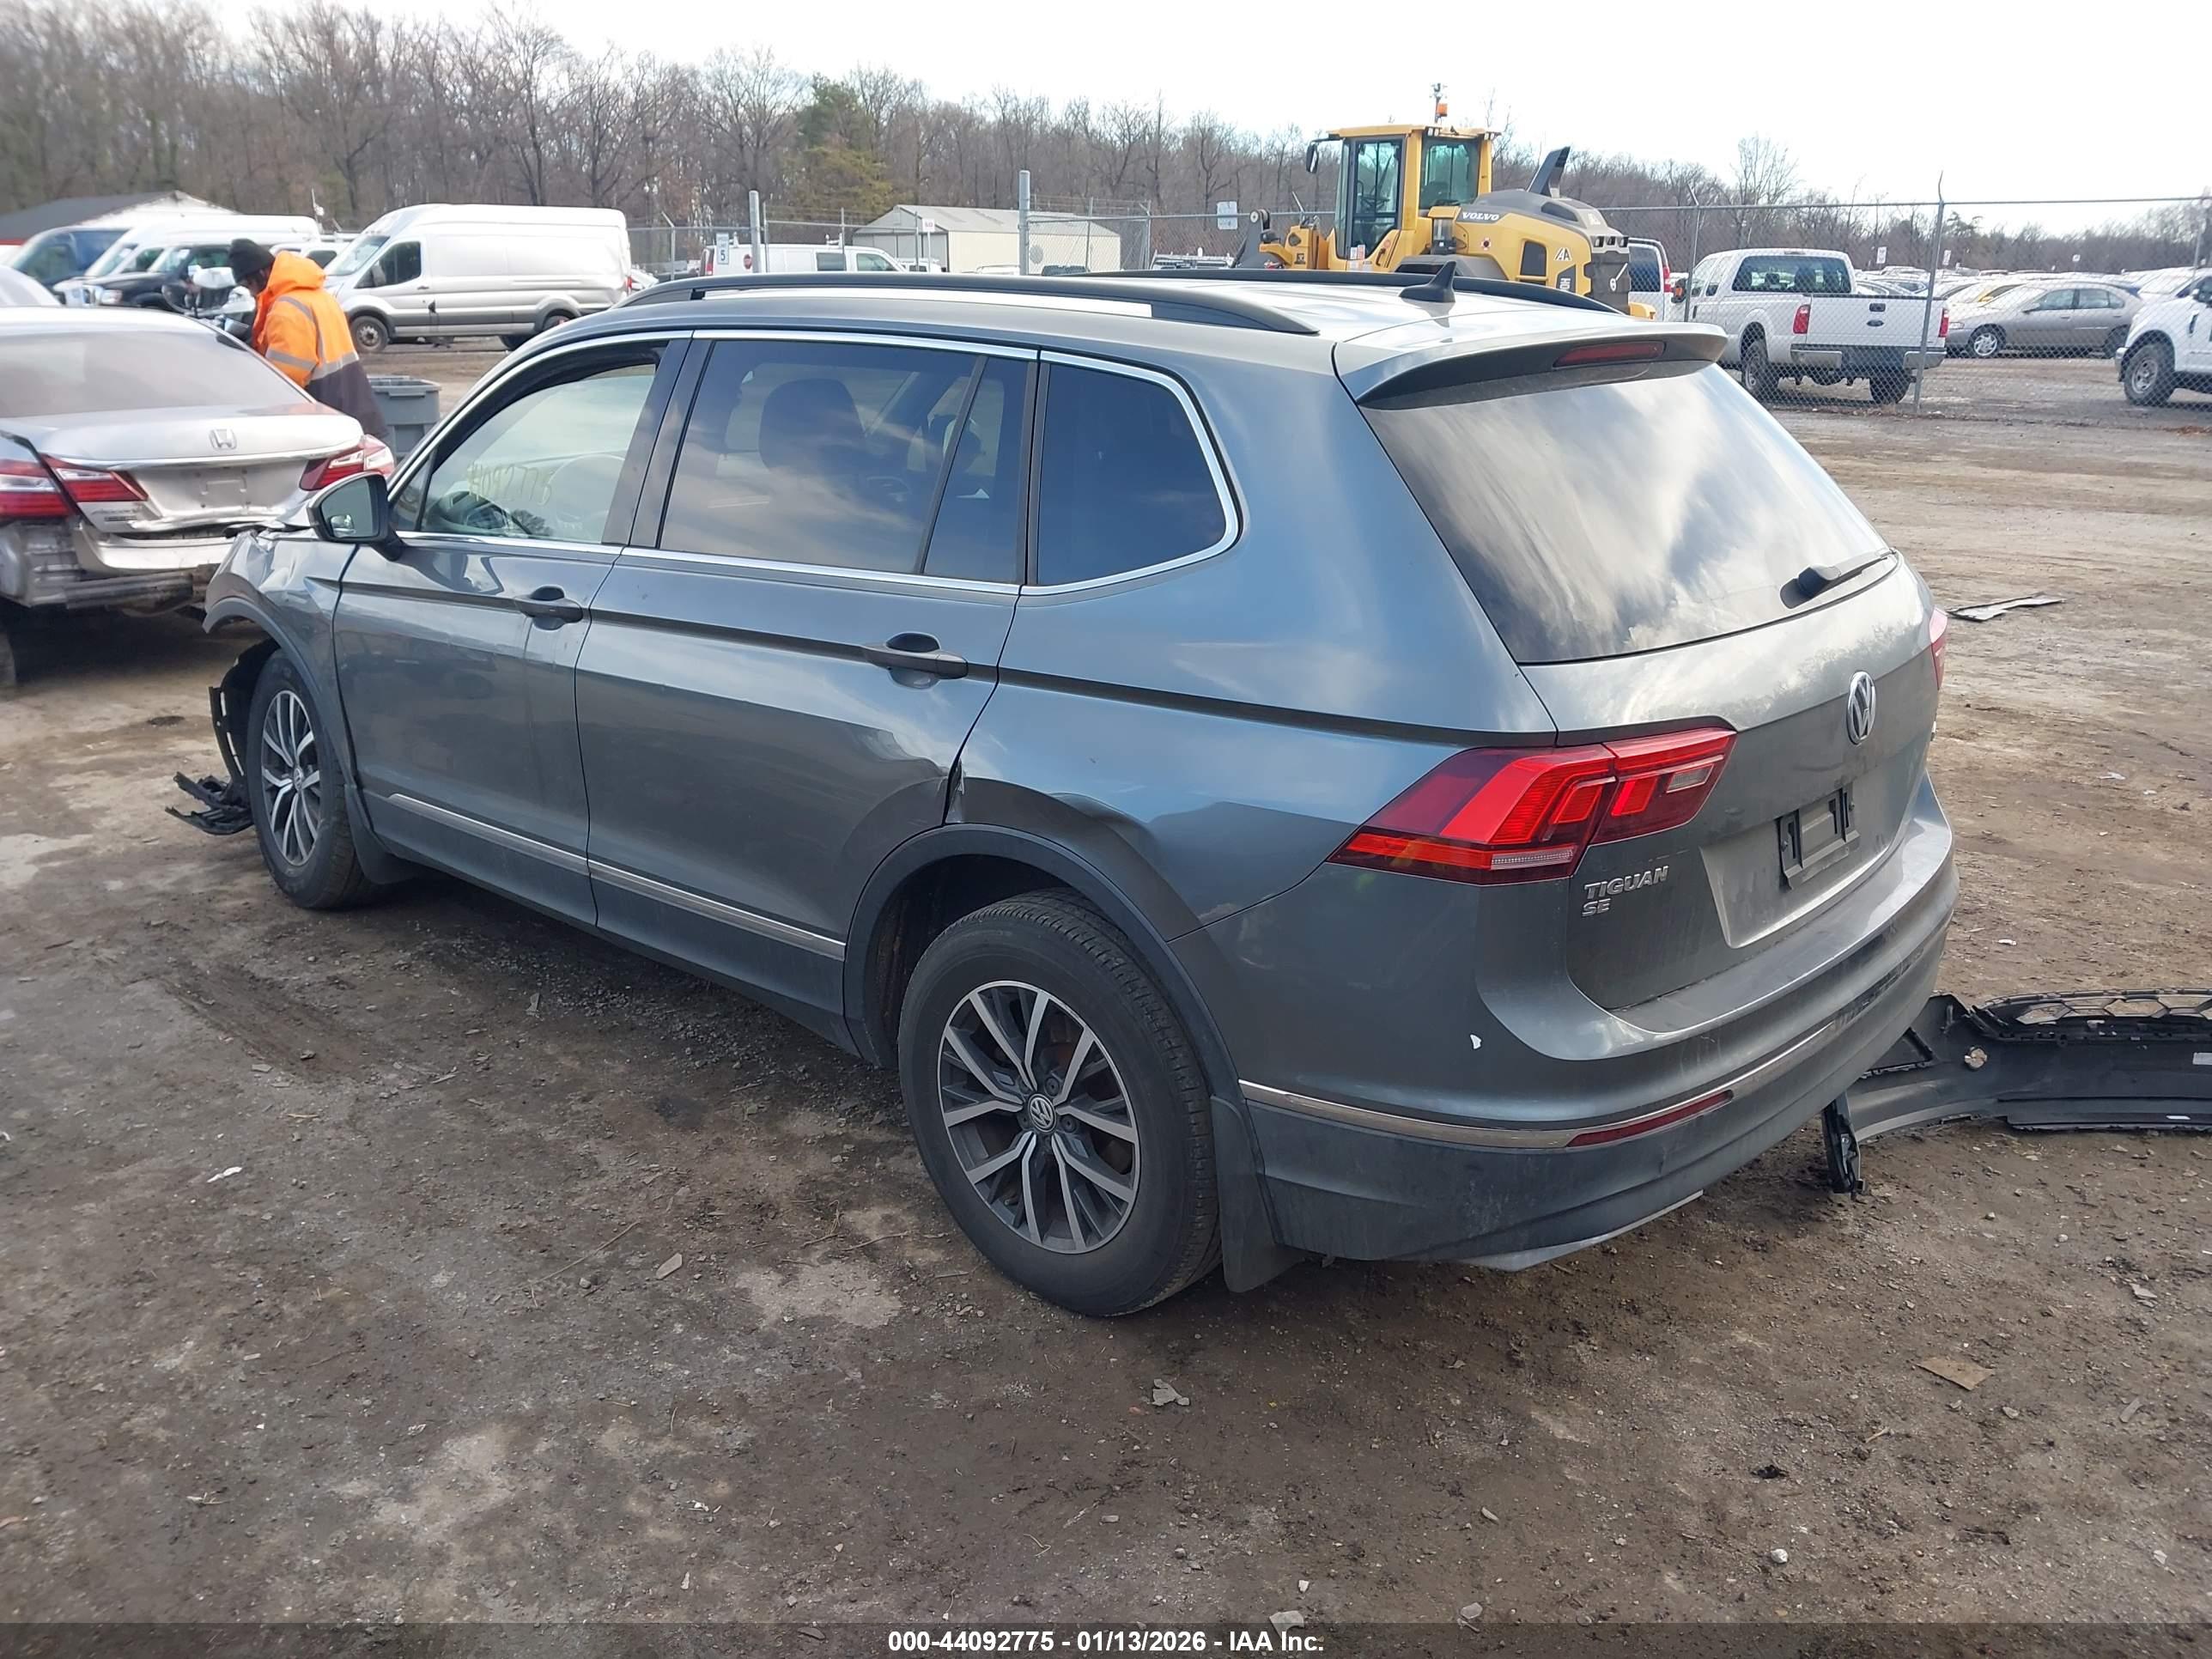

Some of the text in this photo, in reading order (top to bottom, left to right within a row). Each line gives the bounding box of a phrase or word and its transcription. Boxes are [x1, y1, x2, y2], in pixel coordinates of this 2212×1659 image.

[1462, 212, 1499, 221] VOLVO
[720, 250, 726, 261] 5
[1583, 866, 1669, 900] TIGUAN
[1582, 898, 1611, 916] SE
